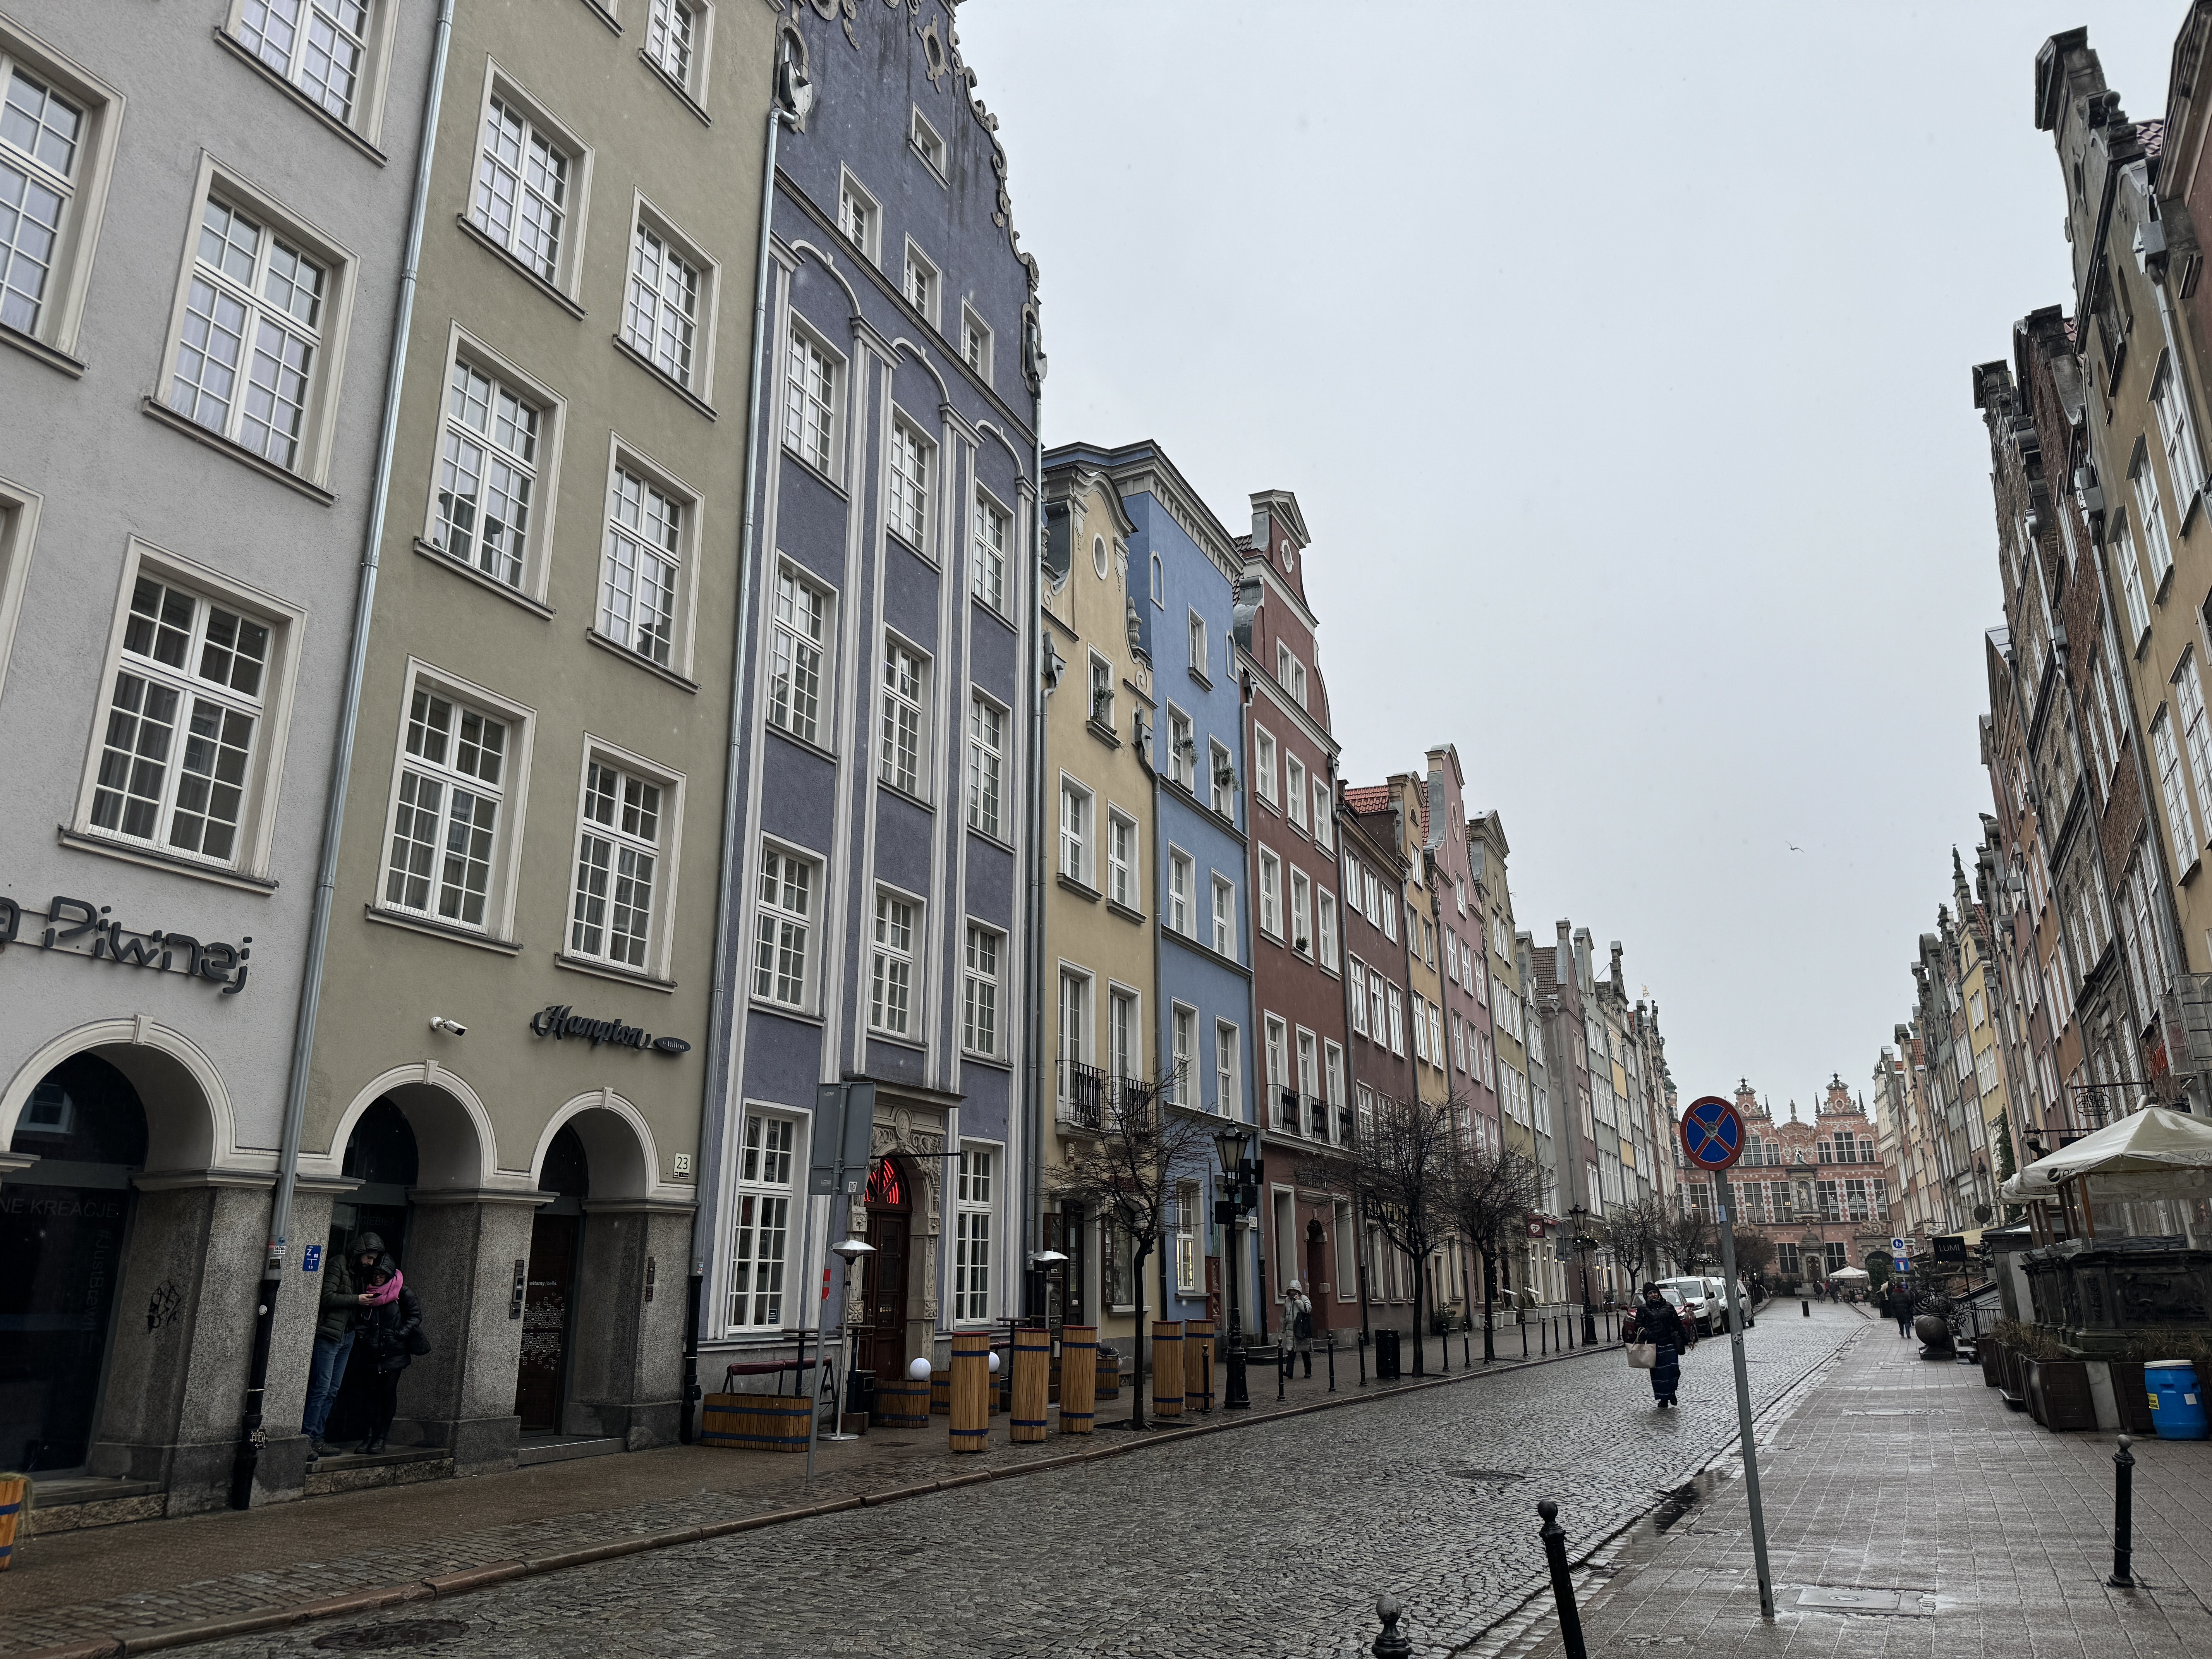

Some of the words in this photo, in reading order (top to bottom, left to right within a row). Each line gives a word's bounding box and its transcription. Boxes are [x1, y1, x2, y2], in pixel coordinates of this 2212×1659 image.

[44, 895, 252, 994] Piwnej
[532, 1005, 652, 1050] Hampton
[668, 1040, 685, 1049] Hilton
[900, 1118, 908, 1130] 22
[677, 1156, 688, 1170] 23
[1939, 1244, 1960, 1252] LUMI
